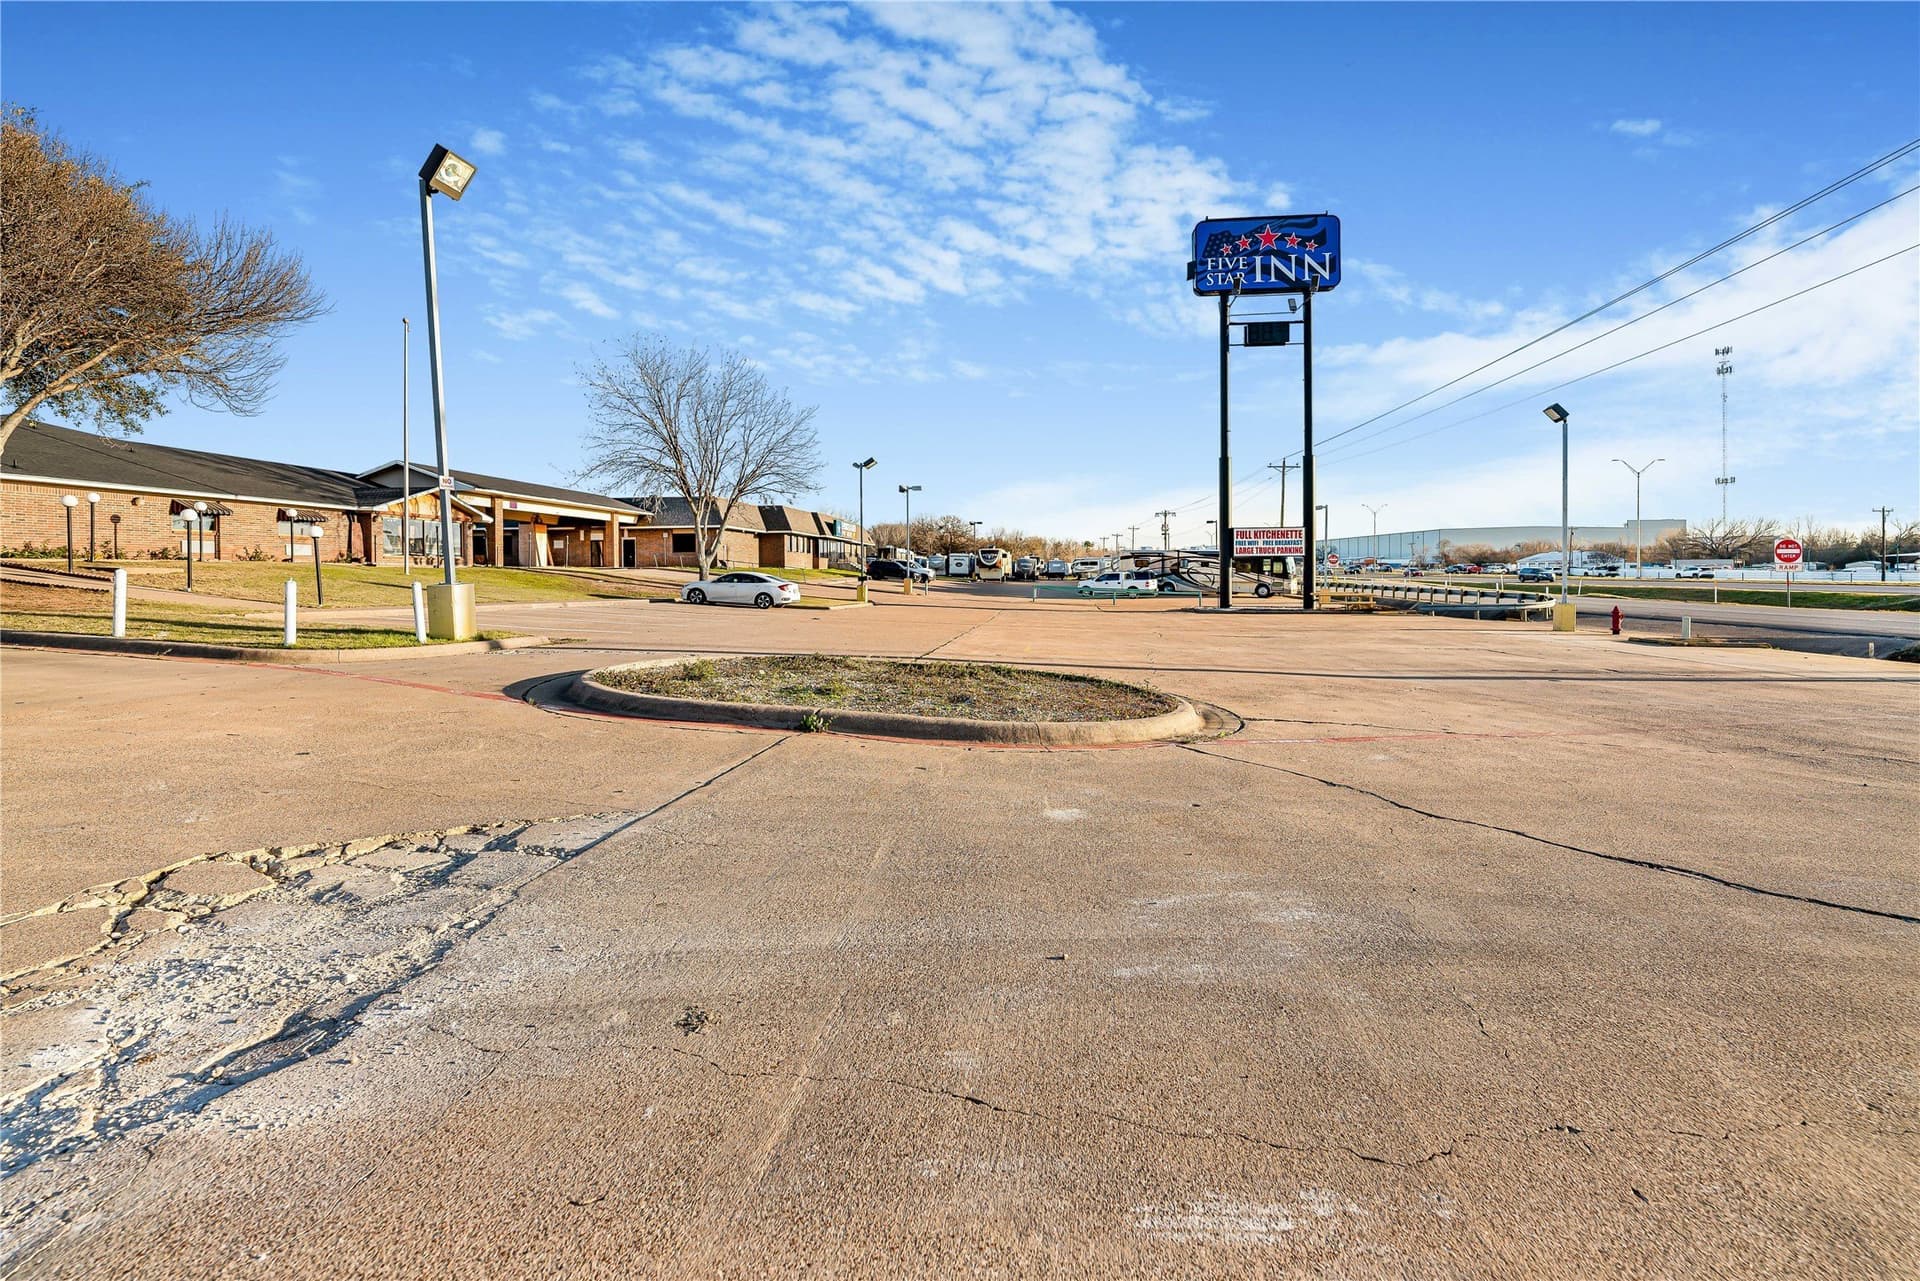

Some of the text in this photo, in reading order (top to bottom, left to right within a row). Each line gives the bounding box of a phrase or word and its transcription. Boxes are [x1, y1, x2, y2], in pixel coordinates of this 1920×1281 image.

[1207, 256, 1248, 271] FIVE
[1252, 252, 1332, 282] INN
[1206, 272, 1248, 286] STAR
[1236, 530, 1302, 539] FULL KITCHENETTE
